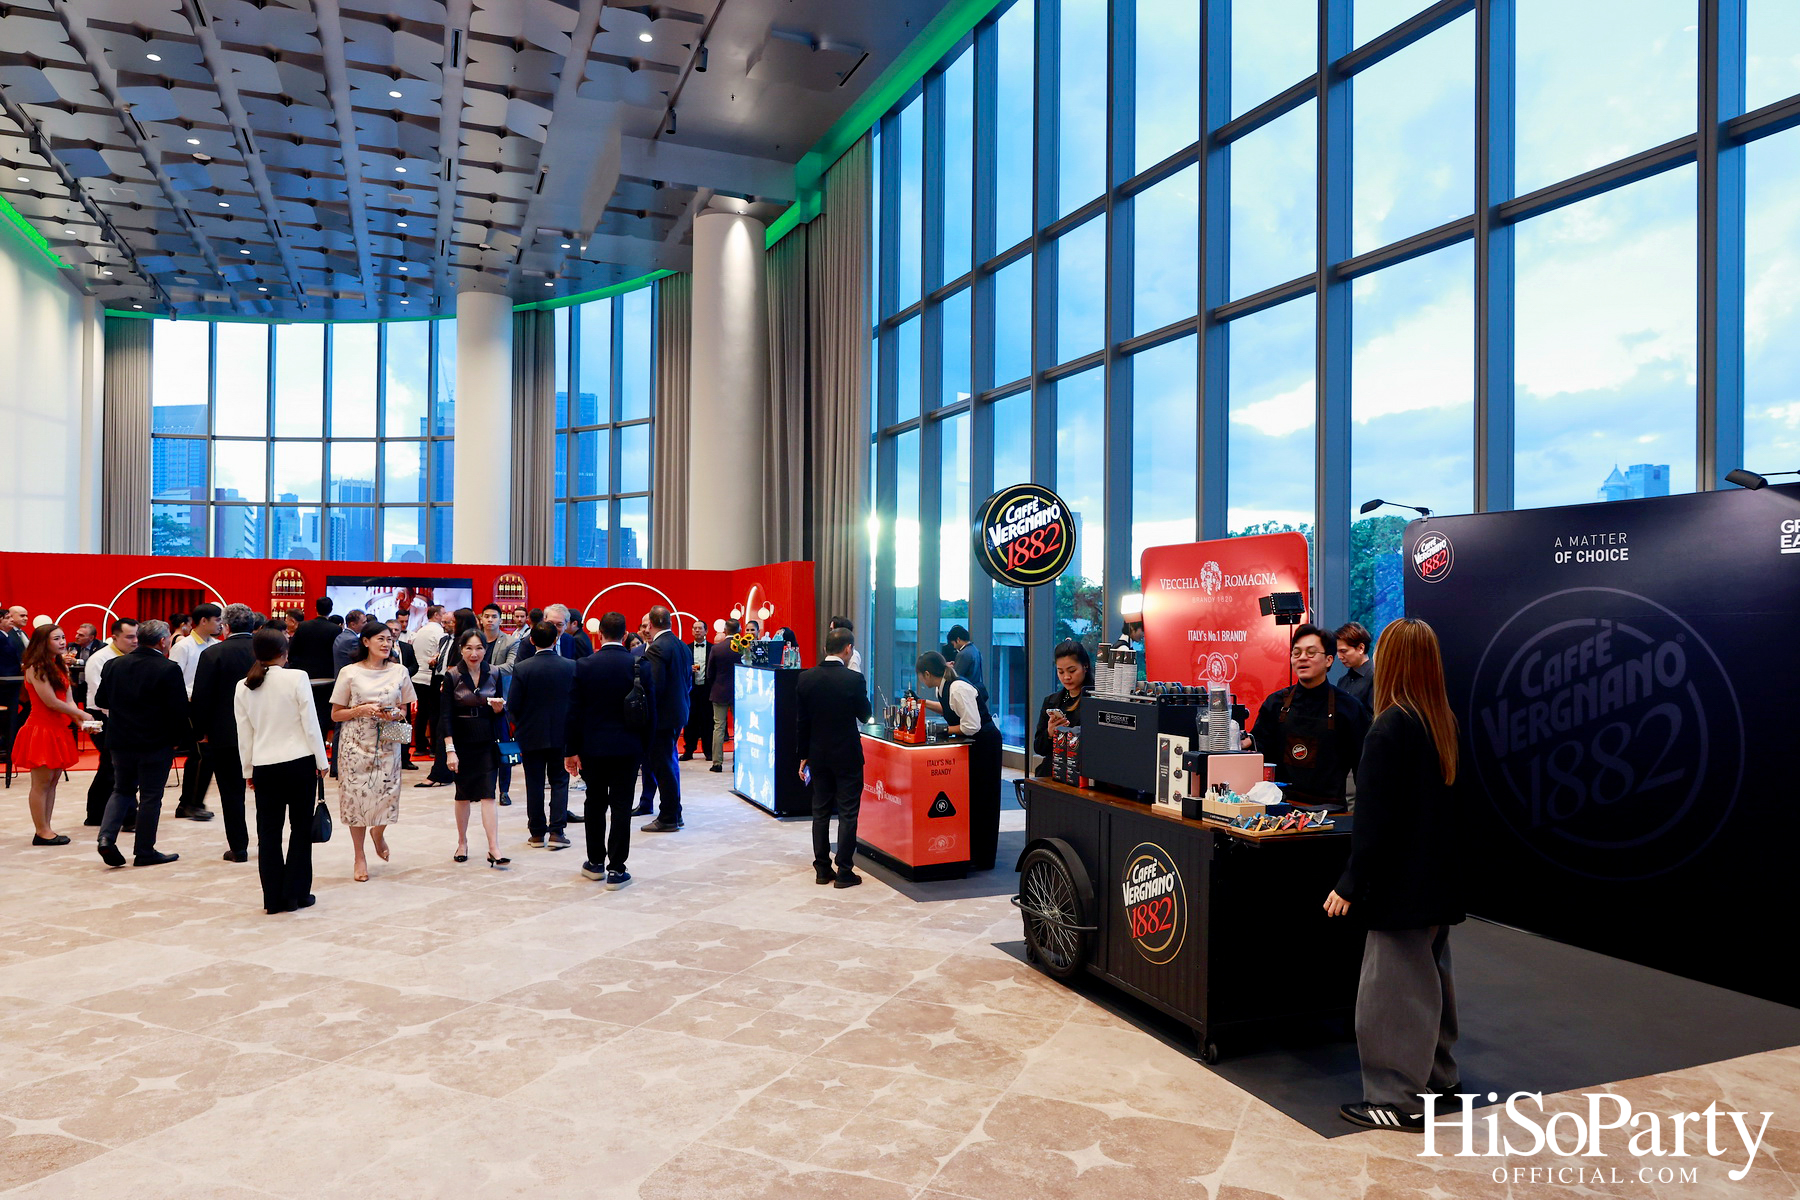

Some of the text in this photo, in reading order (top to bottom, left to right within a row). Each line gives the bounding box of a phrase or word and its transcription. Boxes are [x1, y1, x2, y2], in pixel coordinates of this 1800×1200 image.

[988, 504, 1060, 548] VERGNANO
[1554, 532, 1628, 548] A MATTER
[1005, 522, 1060, 572] 1882
[1554, 547, 1630, 564] OF CHOICE
[1421, 549, 1447, 578] 1882
[1160, 572, 1279, 591] VECCHIA ROMAGNA
[1191, 595, 1233, 604] BRANDY 1820
[1187, 630, 1207, 642] ITALY's
[1221, 630, 1248, 642] BRANDY
[1480, 640, 1687, 759] VERGNANO
[931, 768, 952, 777] BRANDY
[1527, 702, 1687, 829] 1882
[1122, 872, 1175, 907] VERGNANO
[1132, 896, 1173, 939] 1882
